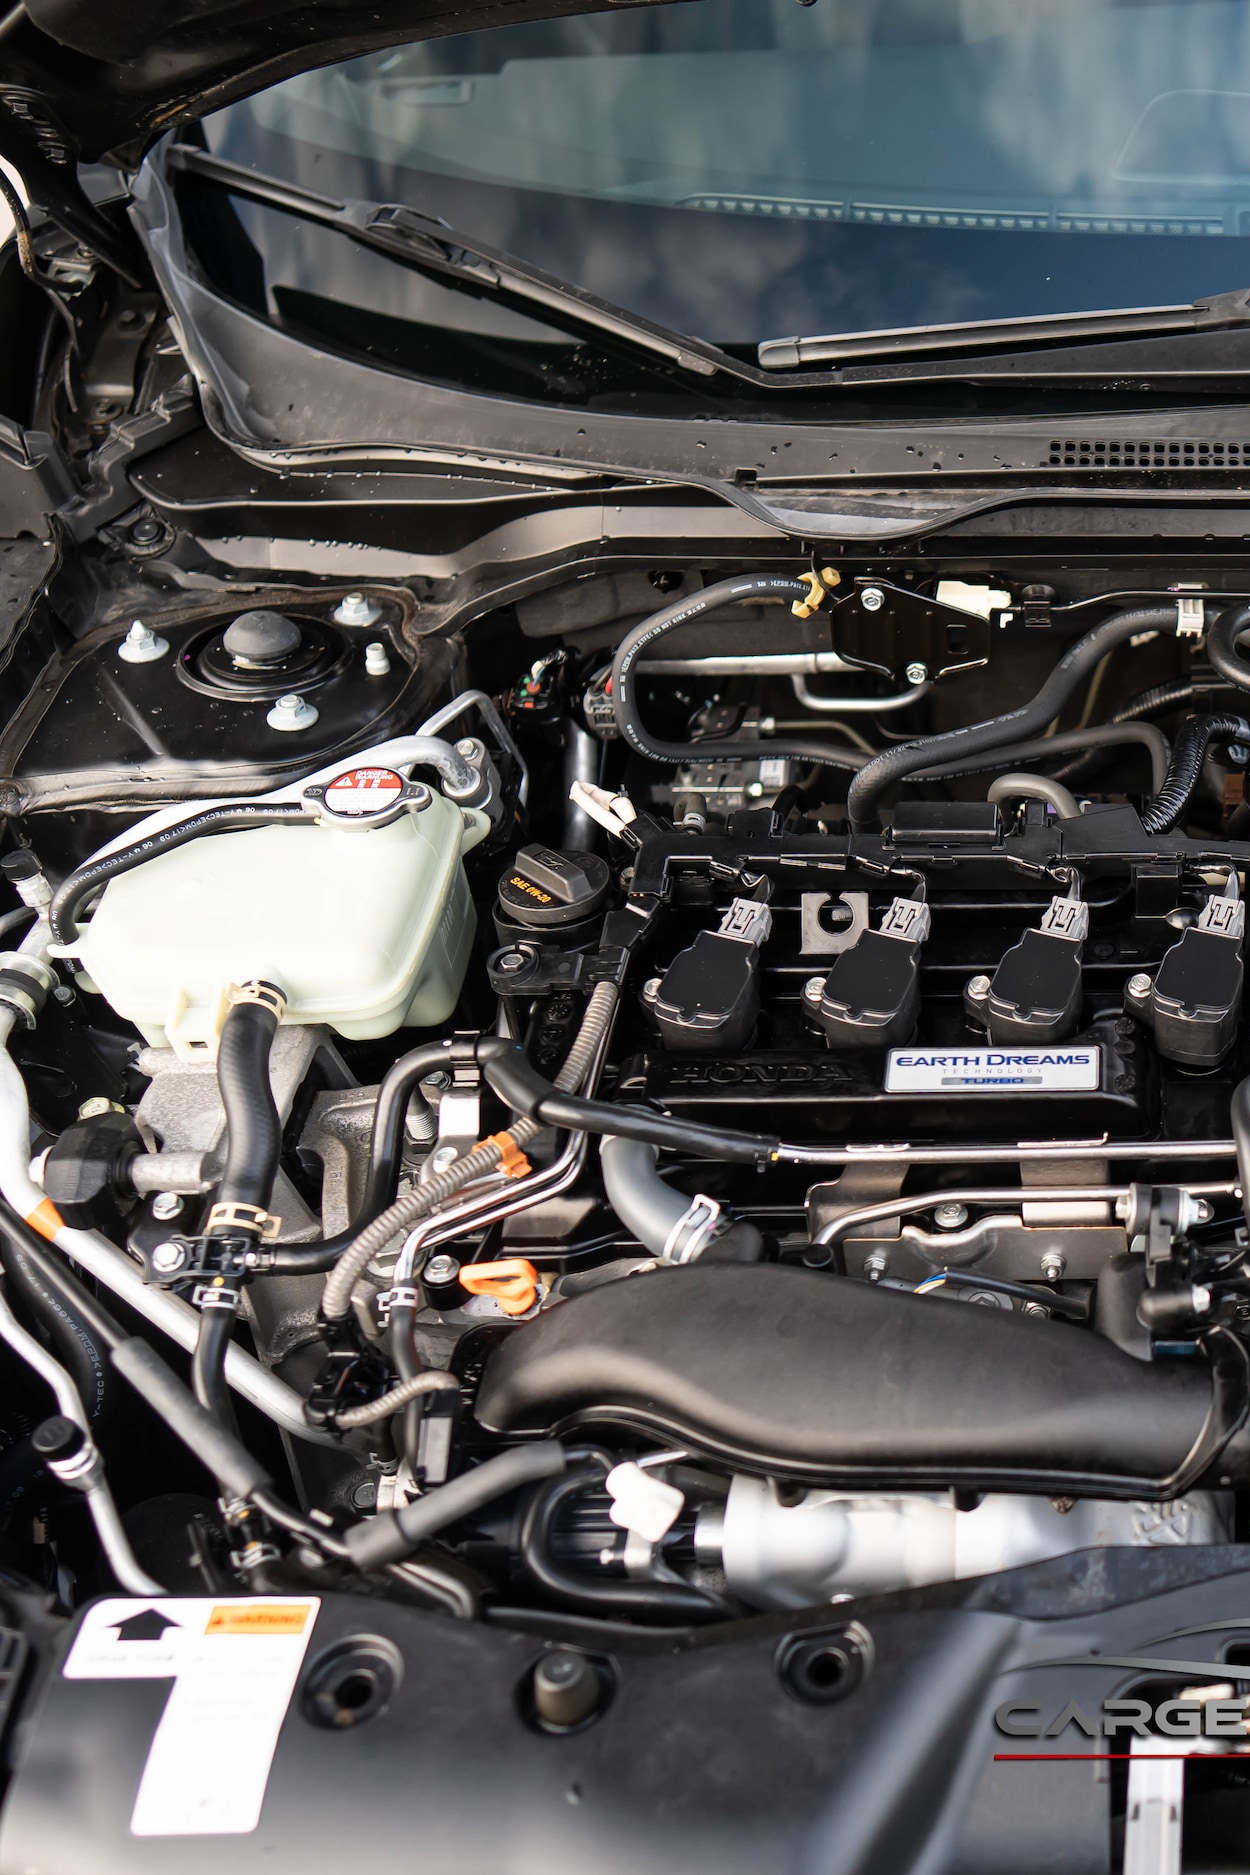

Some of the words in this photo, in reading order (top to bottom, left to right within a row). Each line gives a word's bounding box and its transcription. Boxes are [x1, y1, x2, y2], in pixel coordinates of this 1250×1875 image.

[510, 876, 530, 891] SAE
[526, 886, 552, 903] 0W-20
[896, 1055, 979, 1067] EARTH
[986, 1054, 1090, 1066] DREAMS
[669, 1061, 854, 1084] HONDA
